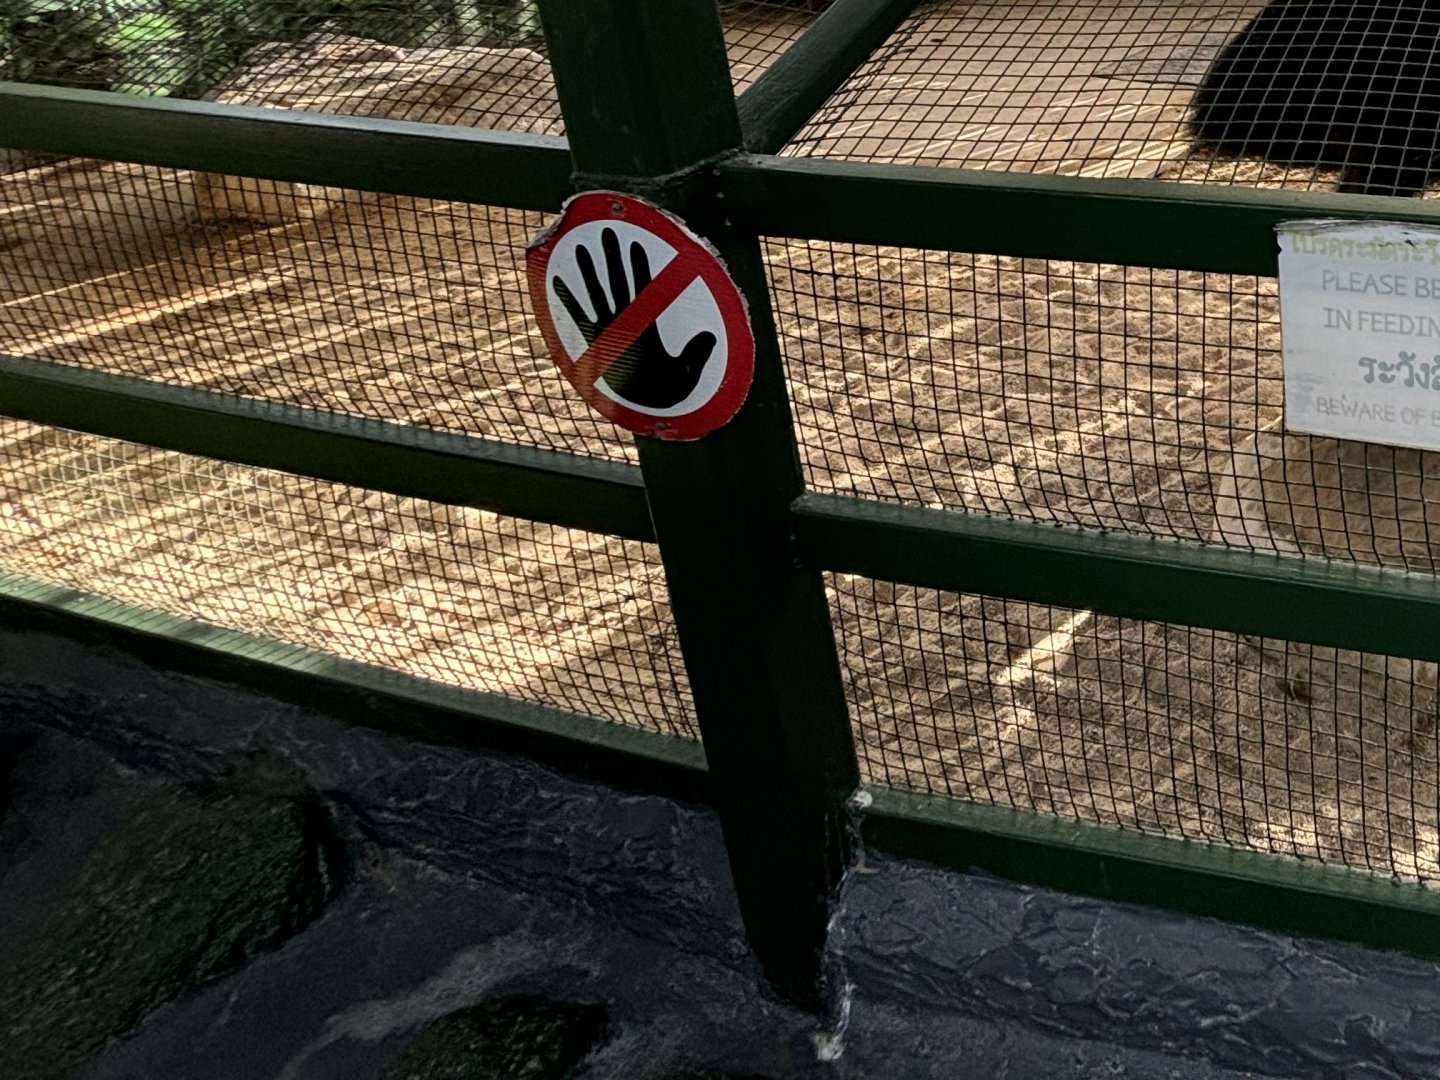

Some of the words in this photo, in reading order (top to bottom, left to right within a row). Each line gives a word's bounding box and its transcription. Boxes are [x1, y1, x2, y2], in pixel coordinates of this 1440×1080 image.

[1321, 269, 1407, 297] PLEASE
[1323, 307, 1351, 331] IN
[1316, 395, 1395, 422] BEWARE
[1400, 406, 1425, 423] OF
